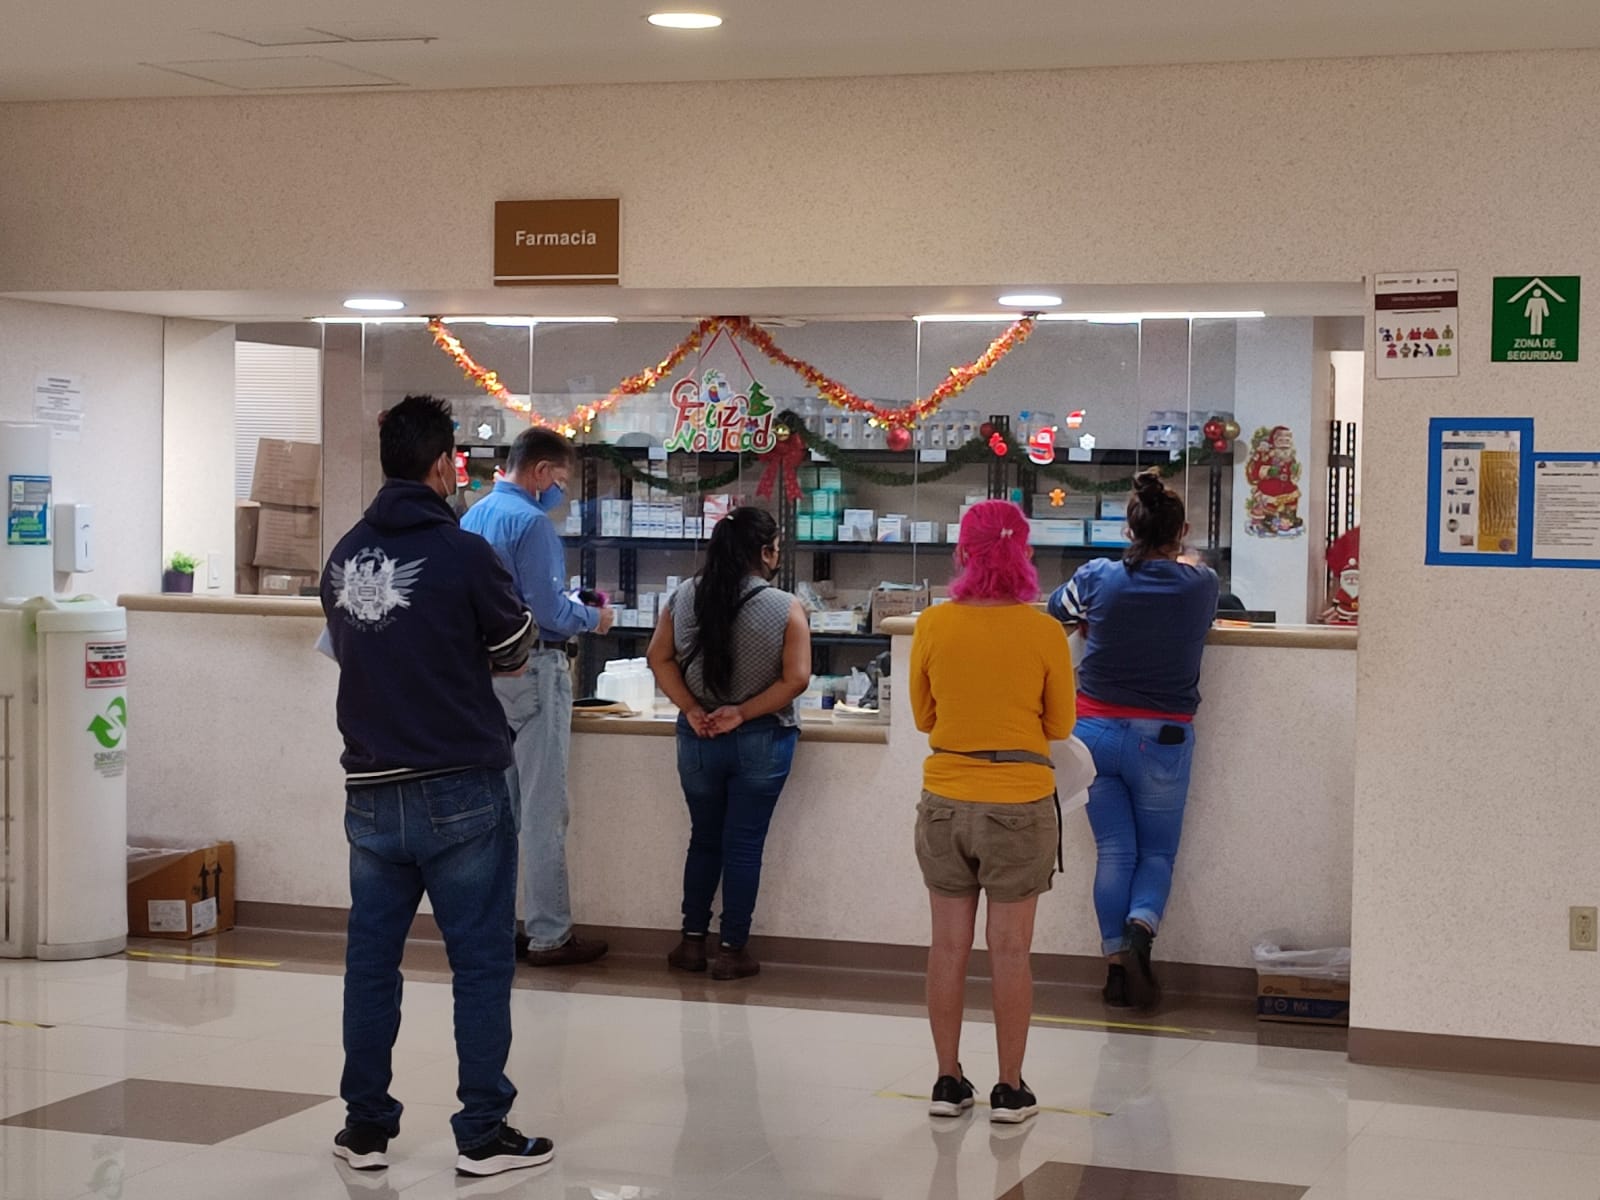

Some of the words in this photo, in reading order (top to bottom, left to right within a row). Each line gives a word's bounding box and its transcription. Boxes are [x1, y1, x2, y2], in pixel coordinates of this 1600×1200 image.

[515, 230, 597, 246] Farmacia
[1513, 338, 1541, 348] ZONA
[1543, 338, 1557, 348] DE
[1507, 350, 1563, 360] SEGURIDAD
